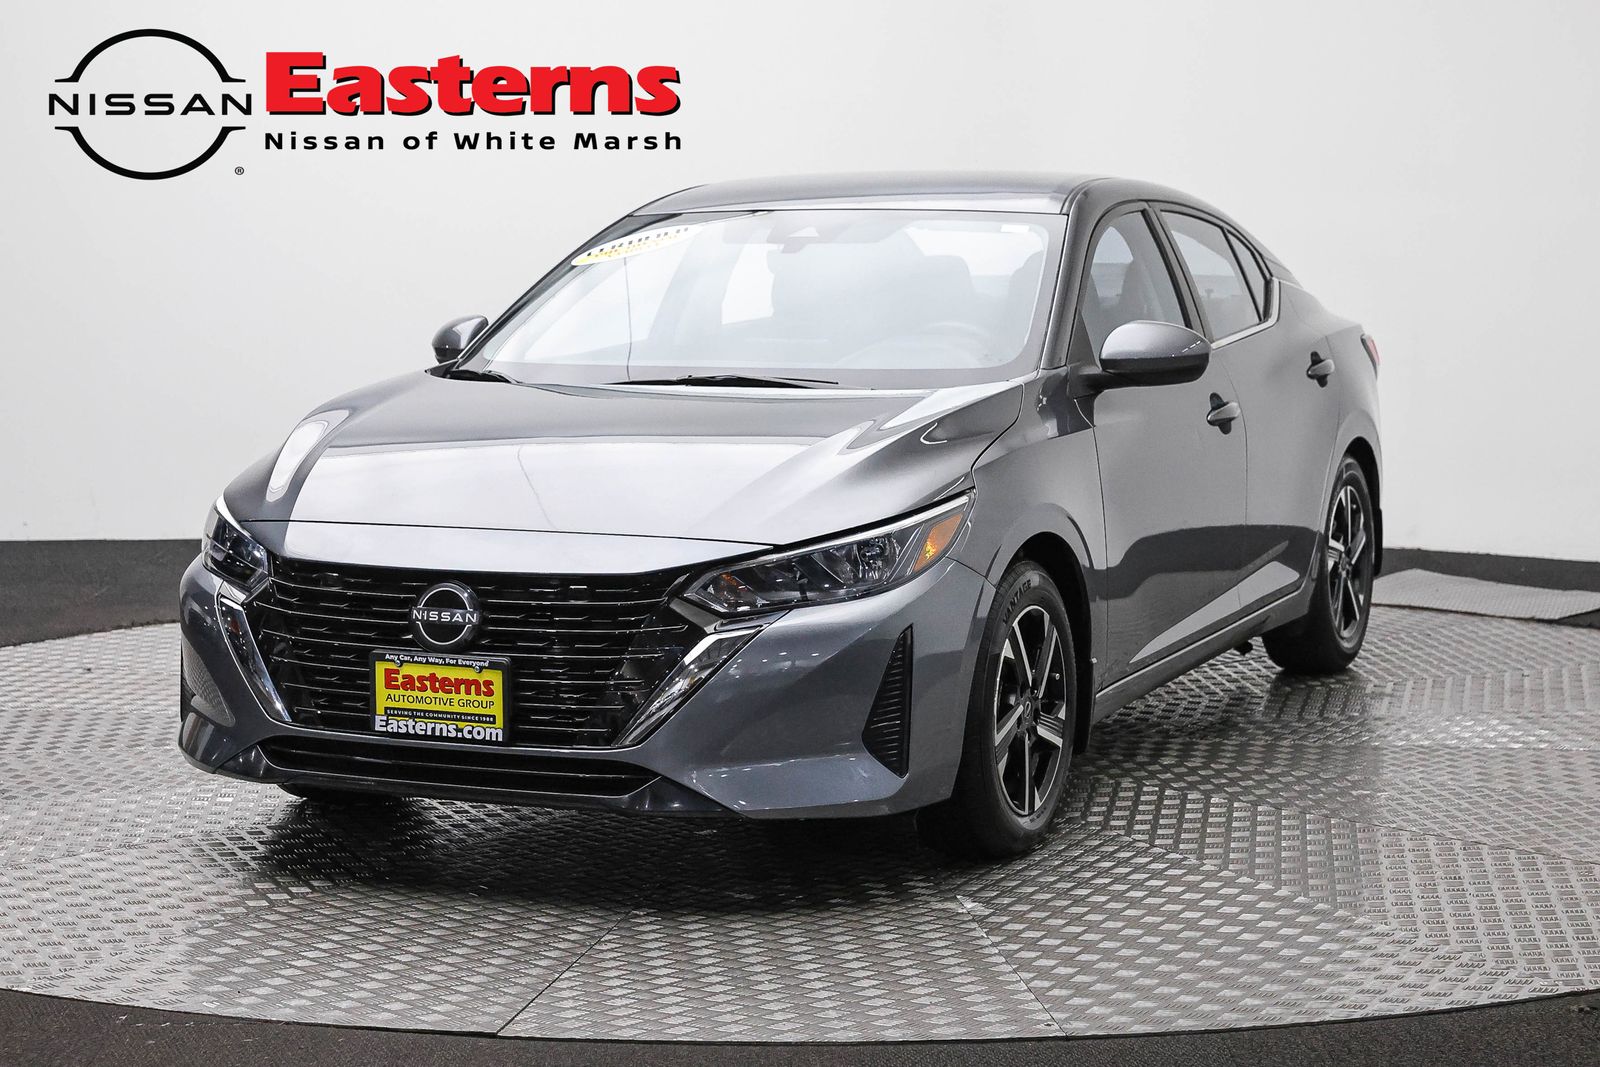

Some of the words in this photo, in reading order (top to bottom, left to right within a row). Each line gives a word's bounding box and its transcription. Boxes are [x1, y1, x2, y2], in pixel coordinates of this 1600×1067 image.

[412, 609, 478, 623] NISSAN
[385, 653, 398, 662] Any
[399, 654, 413, 662] Car,
[413, 655, 427, 663] Any
[428, 656, 445, 664] Way,
[384, 668, 494, 697] Easterns
[385, 693, 455, 707] AUTOMOTIVE
[457, 698, 495, 709] GROUP
[374, 715, 503, 742] Easterns.com
